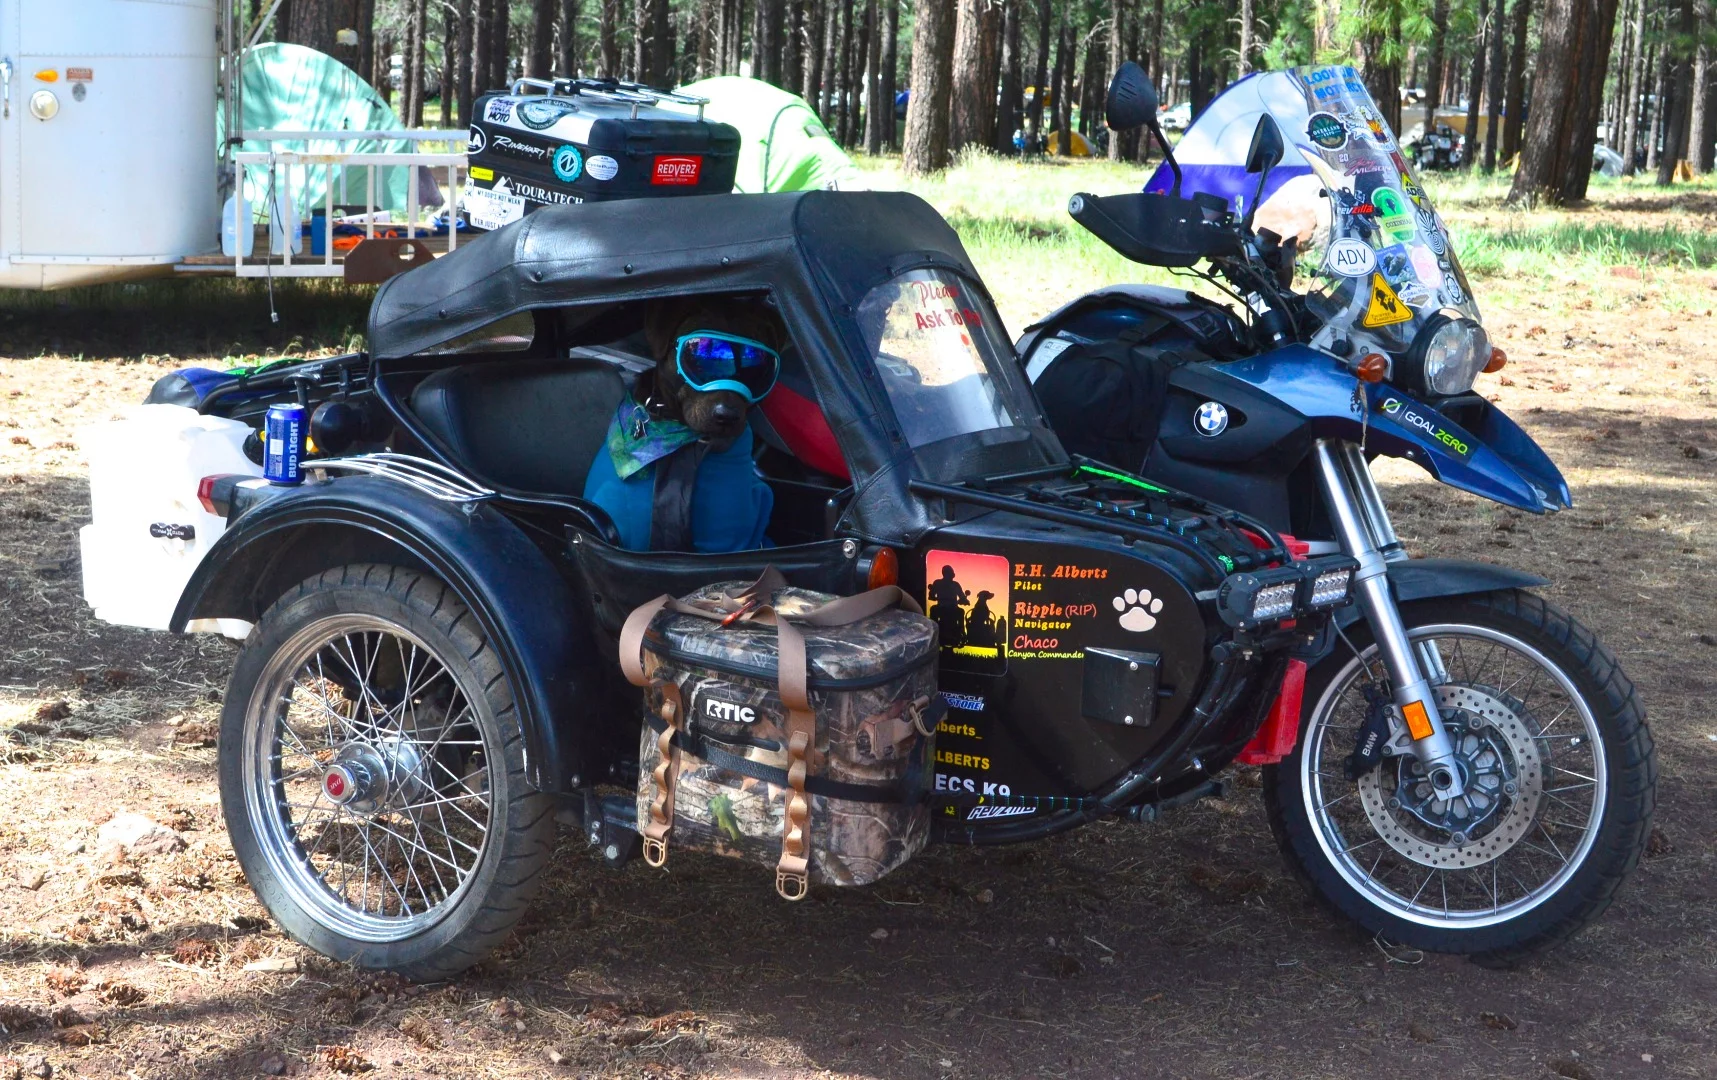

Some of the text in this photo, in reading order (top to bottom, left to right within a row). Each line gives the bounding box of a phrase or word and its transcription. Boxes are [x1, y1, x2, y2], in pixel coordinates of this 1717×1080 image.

[488, 112, 511, 123] MOTO
[1312, 124, 1341, 136] OVERLAND
[657, 164, 697, 177] REDVERZ
[497, 193, 507, 202] NOT
[515, 182, 584, 205] TOURATECH
[1337, 248, 1366, 266] ADV
[915, 310, 946, 330] Ask
[945, 308, 963, 326] To
[288, 421, 299, 478] BUD LIGHT
[1014, 563, 1108, 579] E.H. Alberts
[1013, 580, 1042, 591] Pilot
[1014, 601, 1098, 619] Ripple (RIP)
[1014, 618, 1072, 631] Navigator
[1013, 634, 1059, 649] Chaco
[1008, 650, 1036, 660] Canyon
[706, 698, 756, 723] RTIC
[1362, 731, 1378, 757] BMW
[934, 750, 990, 770] LBERTS
